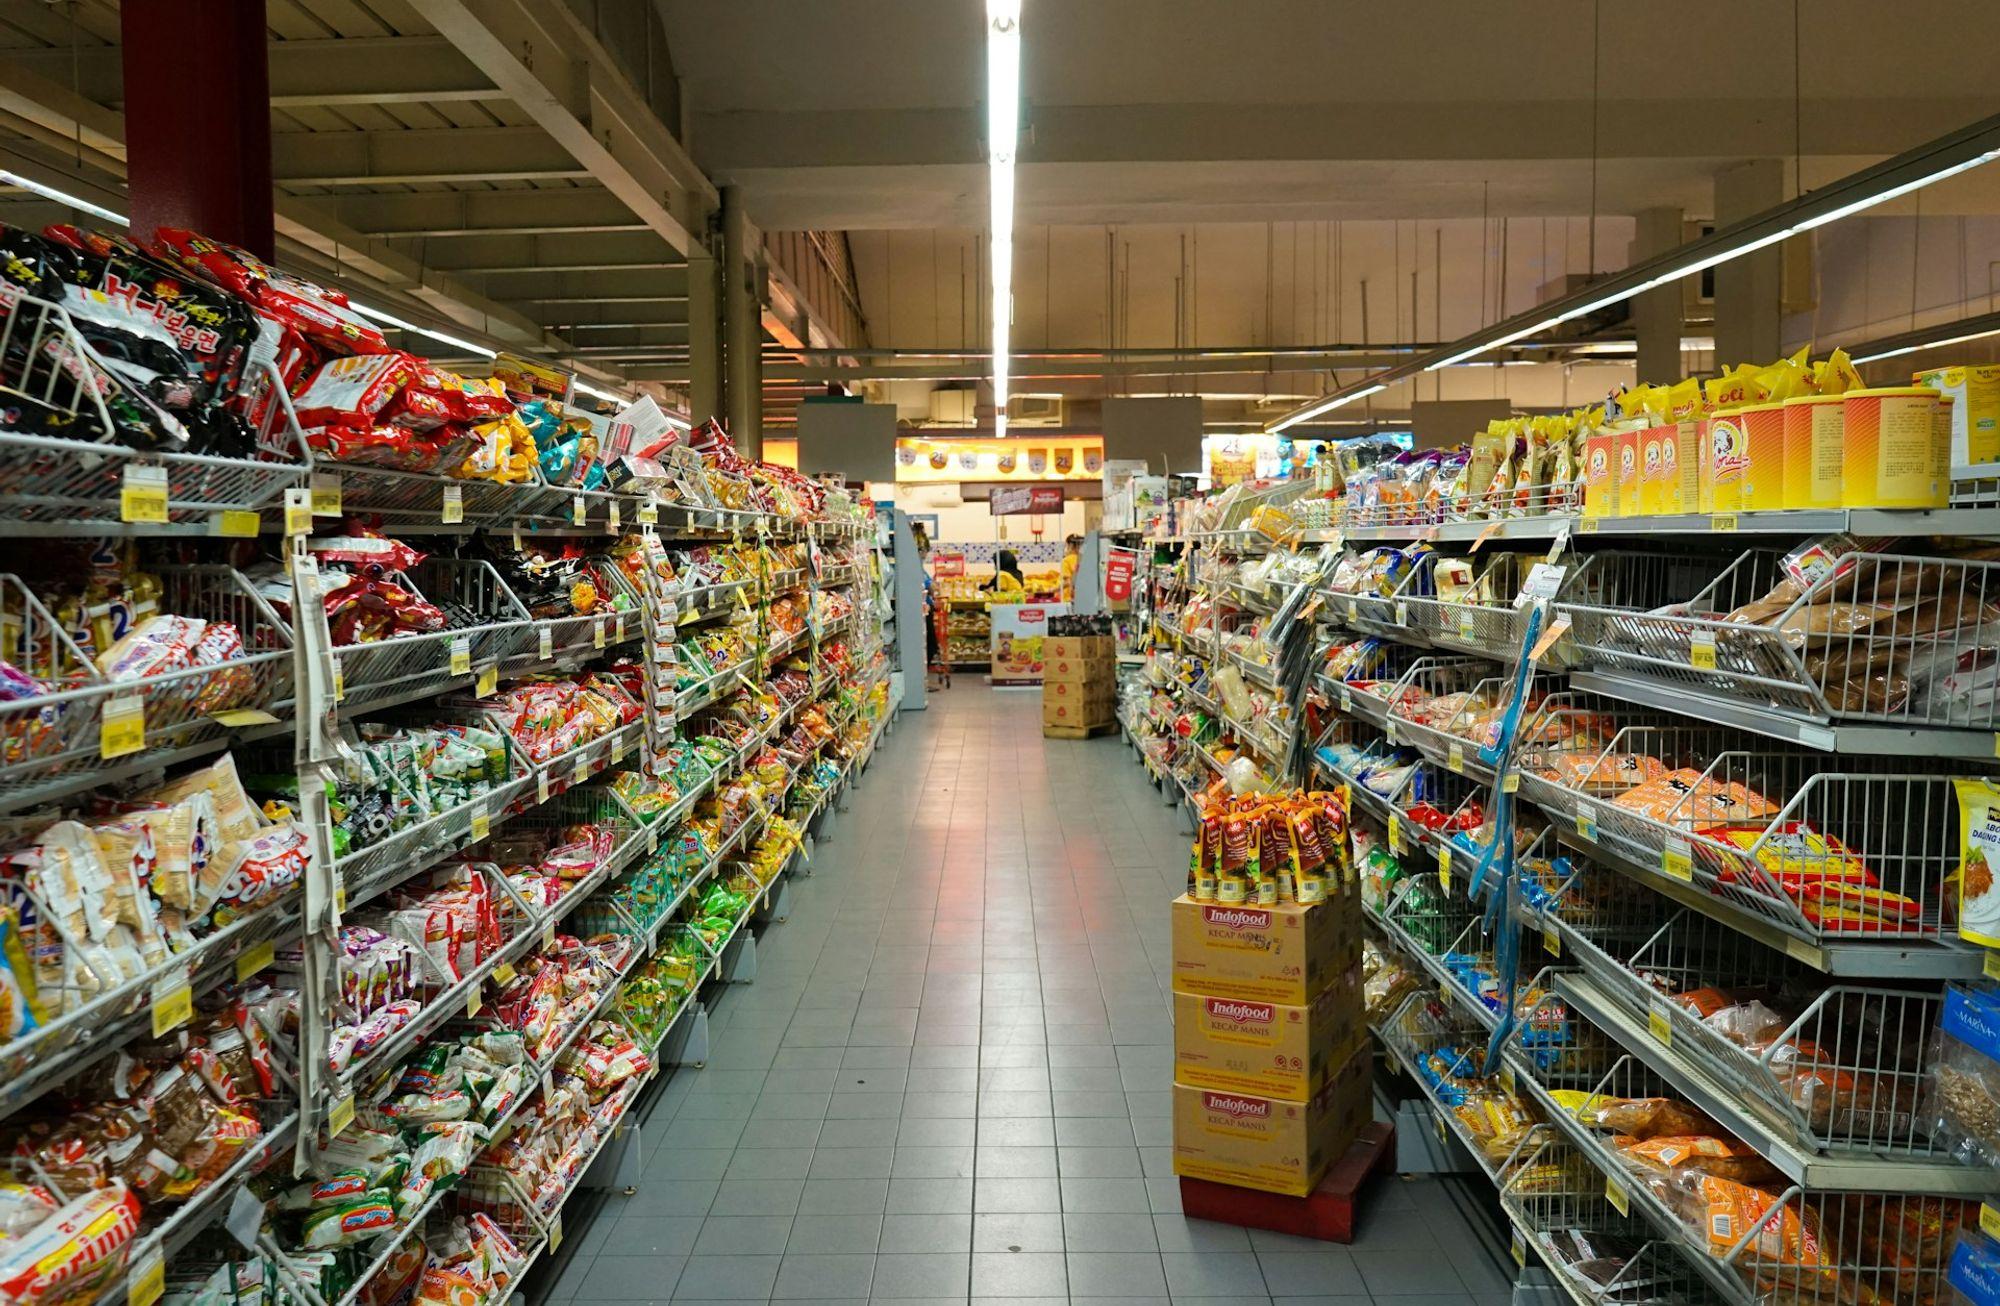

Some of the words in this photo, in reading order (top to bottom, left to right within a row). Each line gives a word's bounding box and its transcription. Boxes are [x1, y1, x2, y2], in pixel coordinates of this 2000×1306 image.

[110, 604, 132, 641] 2
[717, 650, 728, 660] 2
[1210, 909, 1267, 927] Indofood
[1208, 929, 1235, 940] KECAP
[1213, 1002, 1270, 1020] Indofood
[1211, 1021, 1238, 1032] KECAP
[1241, 1026, 1269, 1036] MANIS
[1210, 1096, 1266, 1114] Indofood
[1208, 1115, 1236, 1127] KECAP
[1238, 1119, 1266, 1131] MANIS
